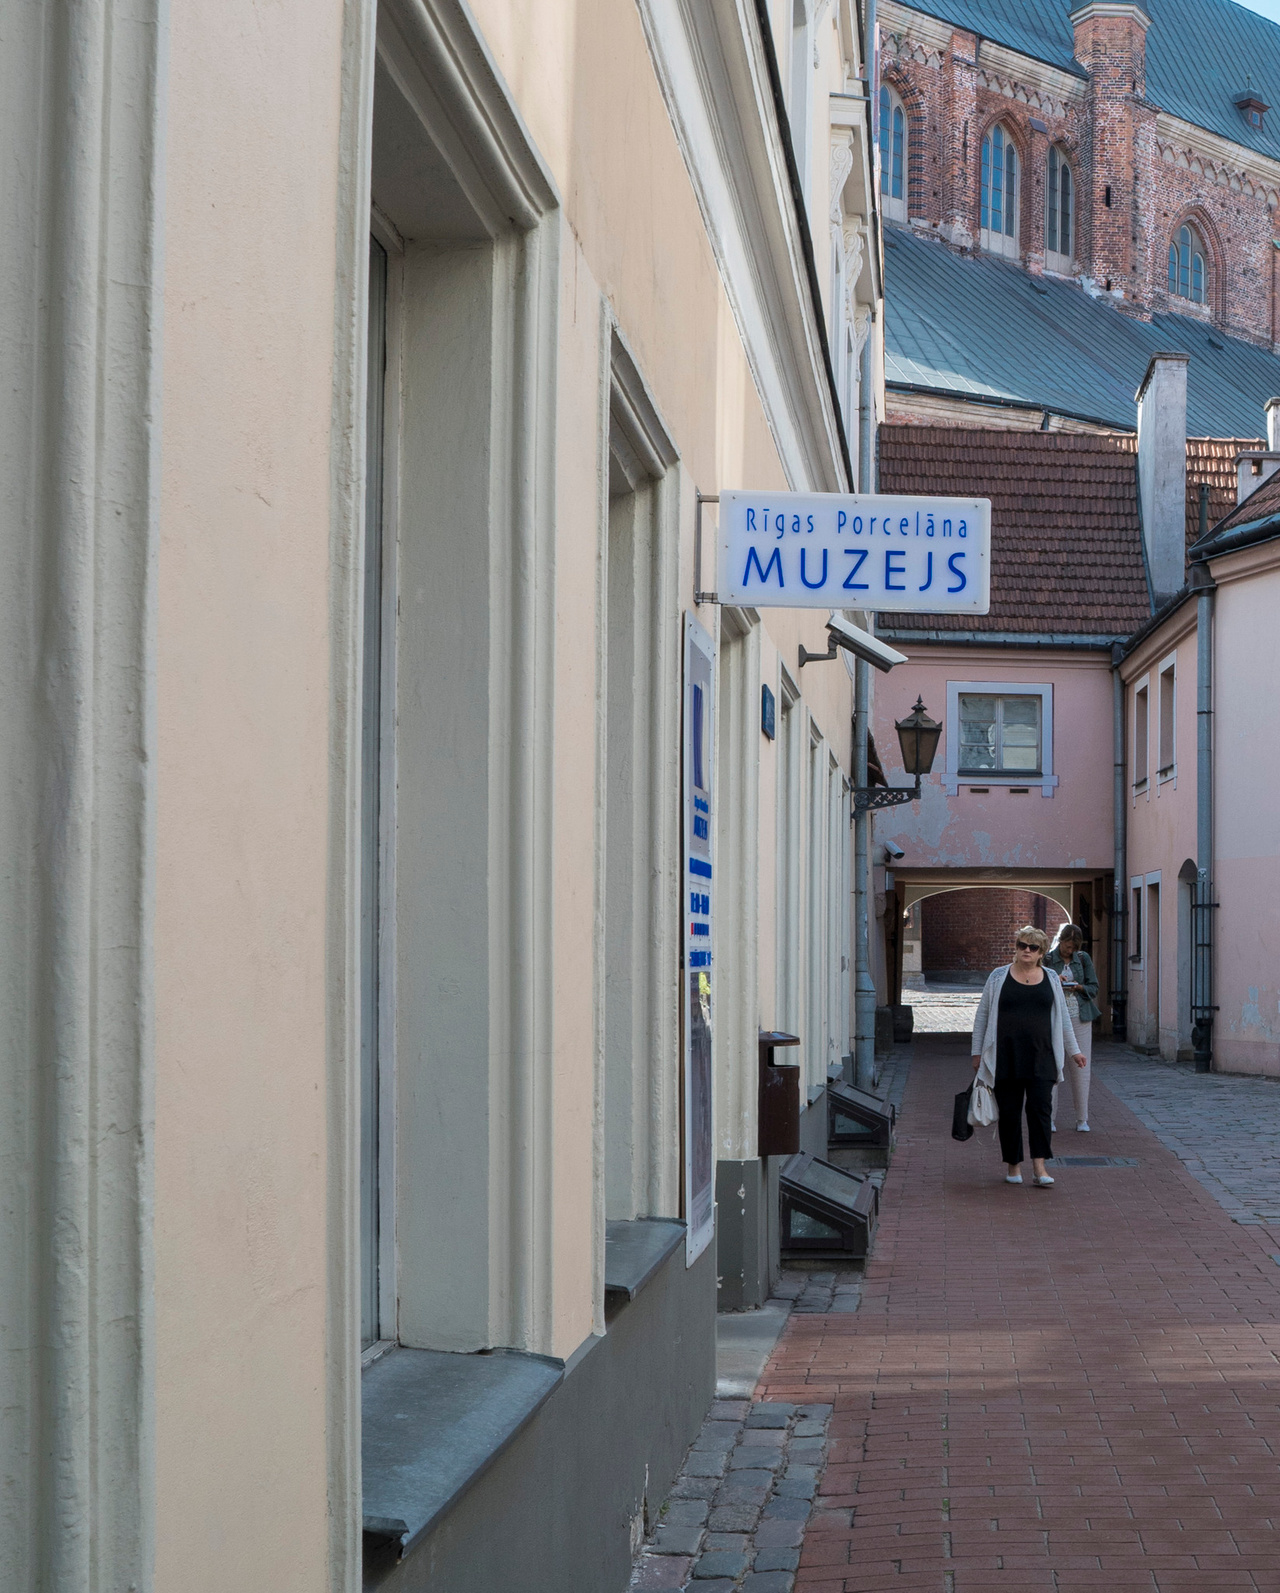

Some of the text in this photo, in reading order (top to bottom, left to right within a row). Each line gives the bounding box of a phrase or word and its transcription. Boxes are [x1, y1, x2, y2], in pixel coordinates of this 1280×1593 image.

[746, 508, 968, 539] Rīgas Porcelāna
[742, 546, 967, 593] MUZEJS
